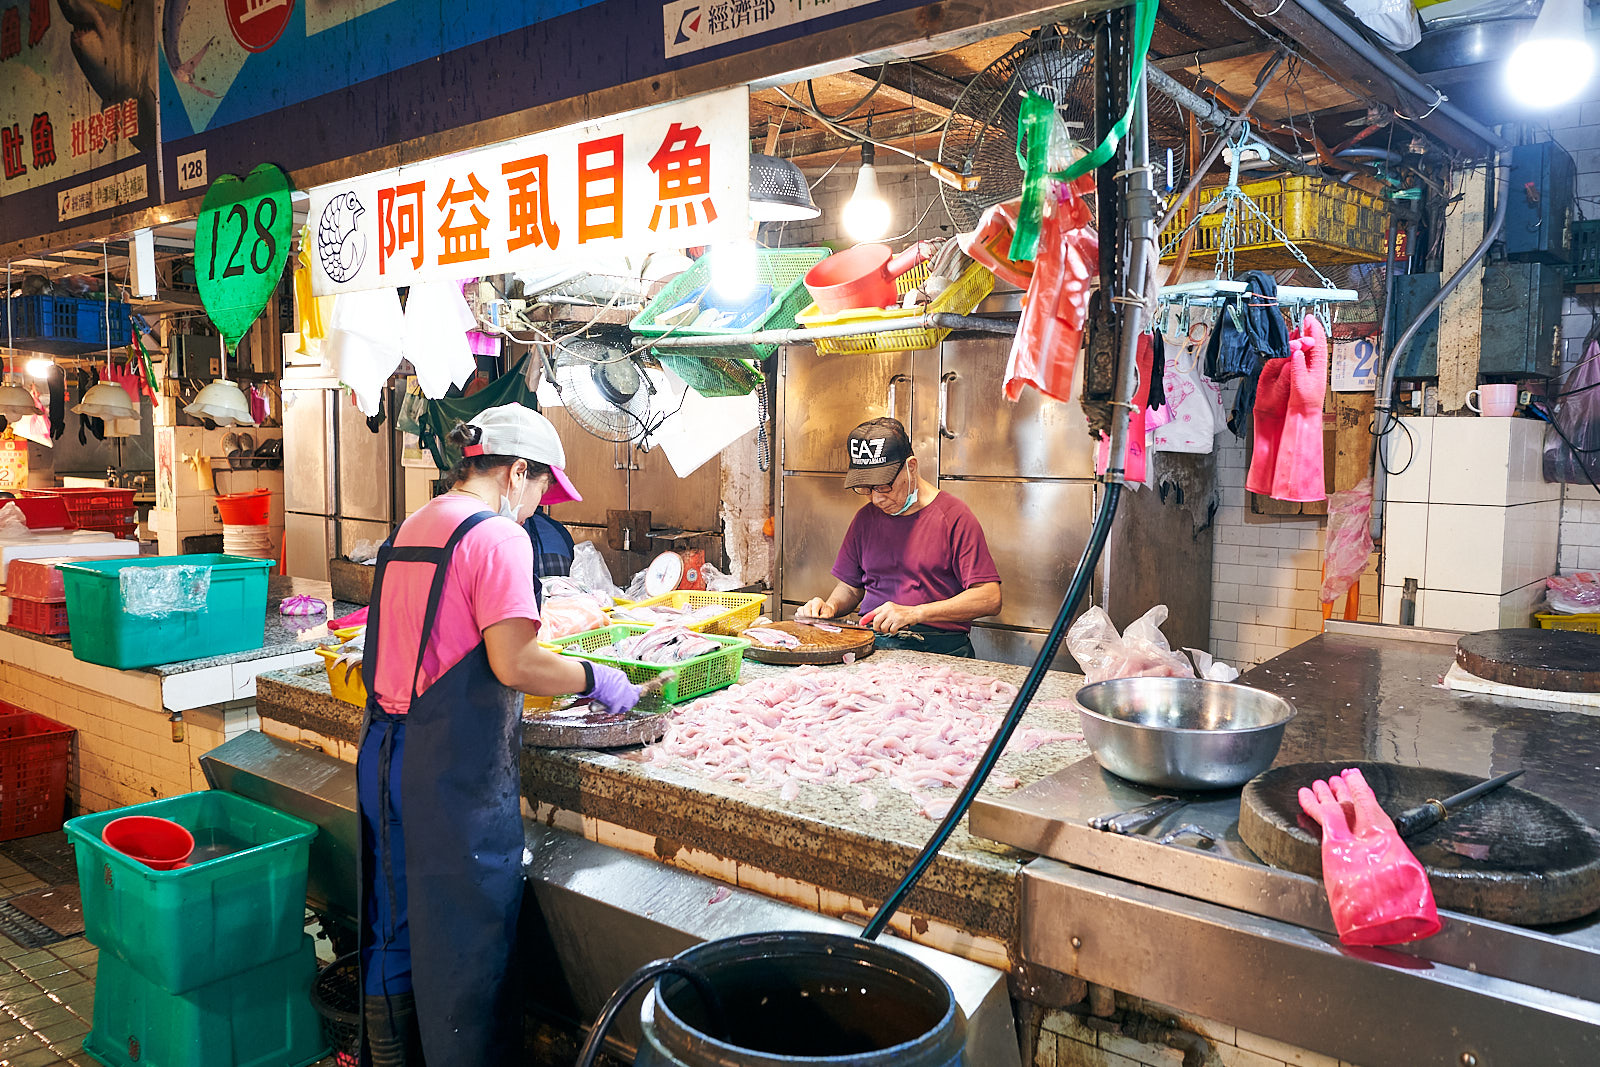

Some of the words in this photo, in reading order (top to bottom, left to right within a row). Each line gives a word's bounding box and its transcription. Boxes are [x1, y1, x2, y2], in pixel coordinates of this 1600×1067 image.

[708, 0, 776, 35] 經濟部
[1, 112, 56, 180] 肚魚
[71, 98, 139, 158] 批發零售
[181, 160, 202, 181] 128
[378, 122, 718, 275] 阿益虱目魚
[209, 198, 277, 281] 128
[850, 438, 886, 459] EA7
